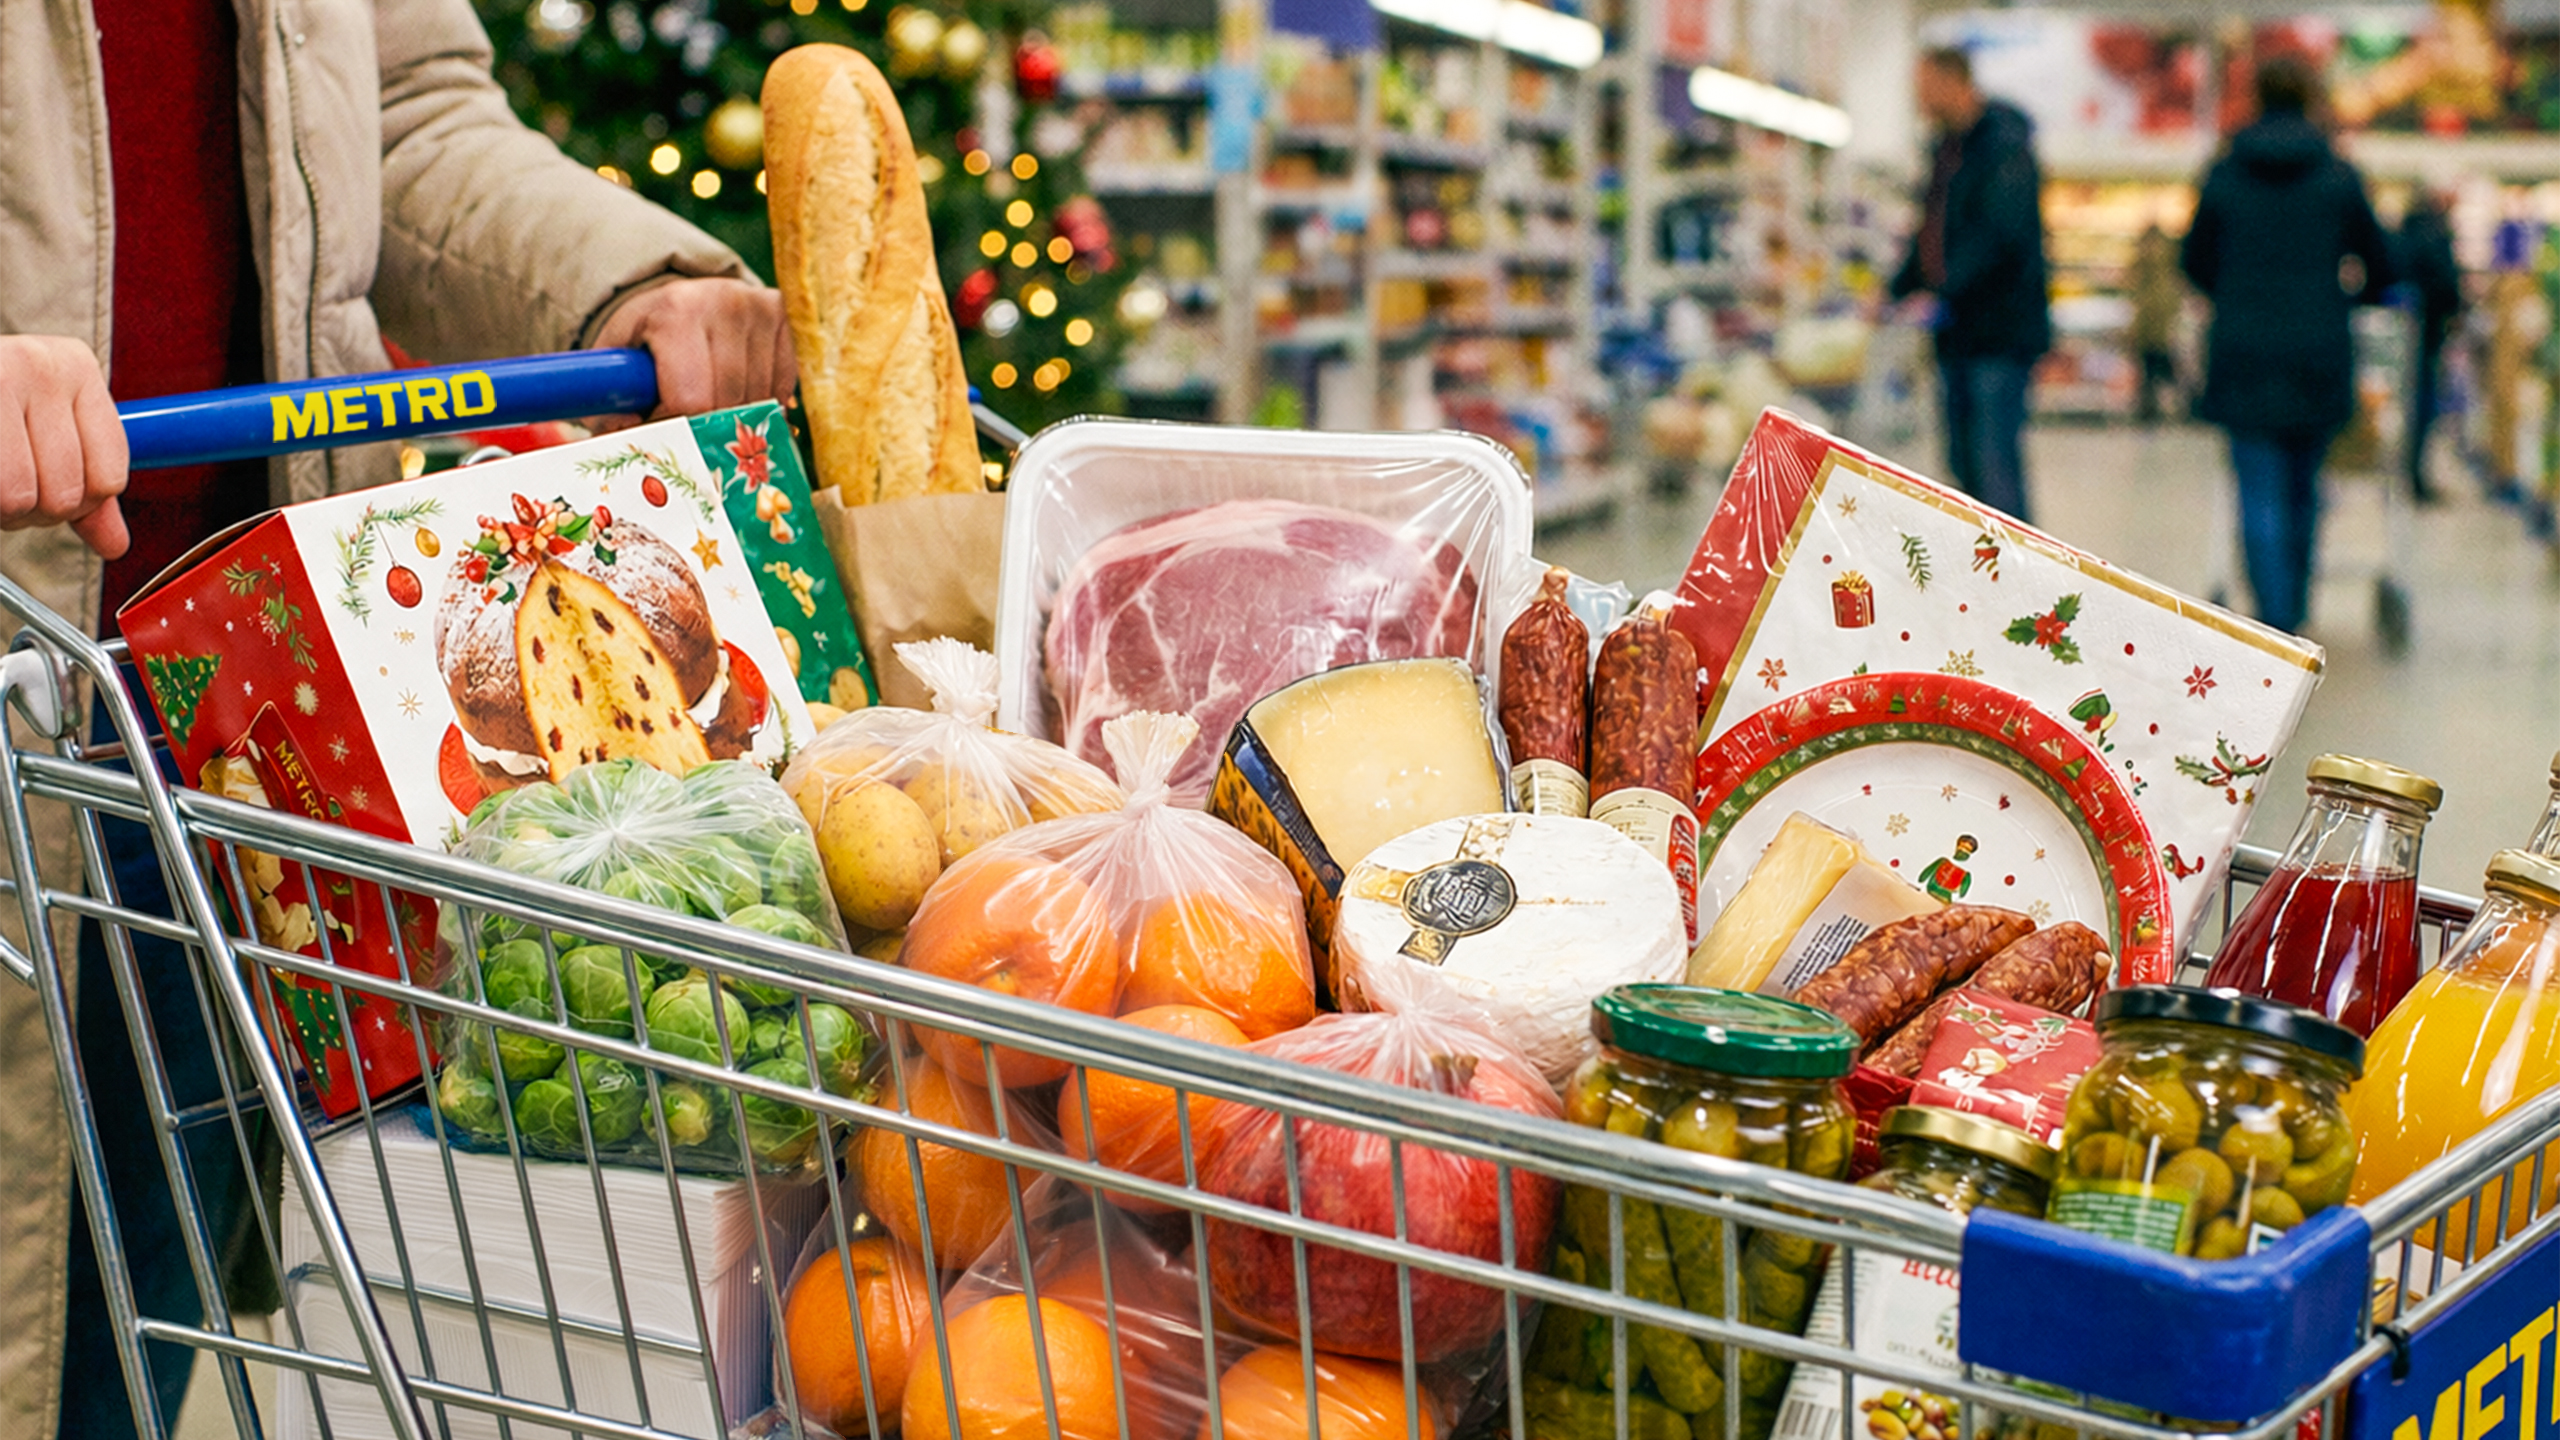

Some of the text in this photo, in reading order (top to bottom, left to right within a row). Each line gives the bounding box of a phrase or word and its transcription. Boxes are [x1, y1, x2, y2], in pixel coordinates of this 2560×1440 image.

[269, 369, 498, 443] METRO
[273, 740, 325, 821] METRO
[2391, 1299, 2560, 1440] ET
